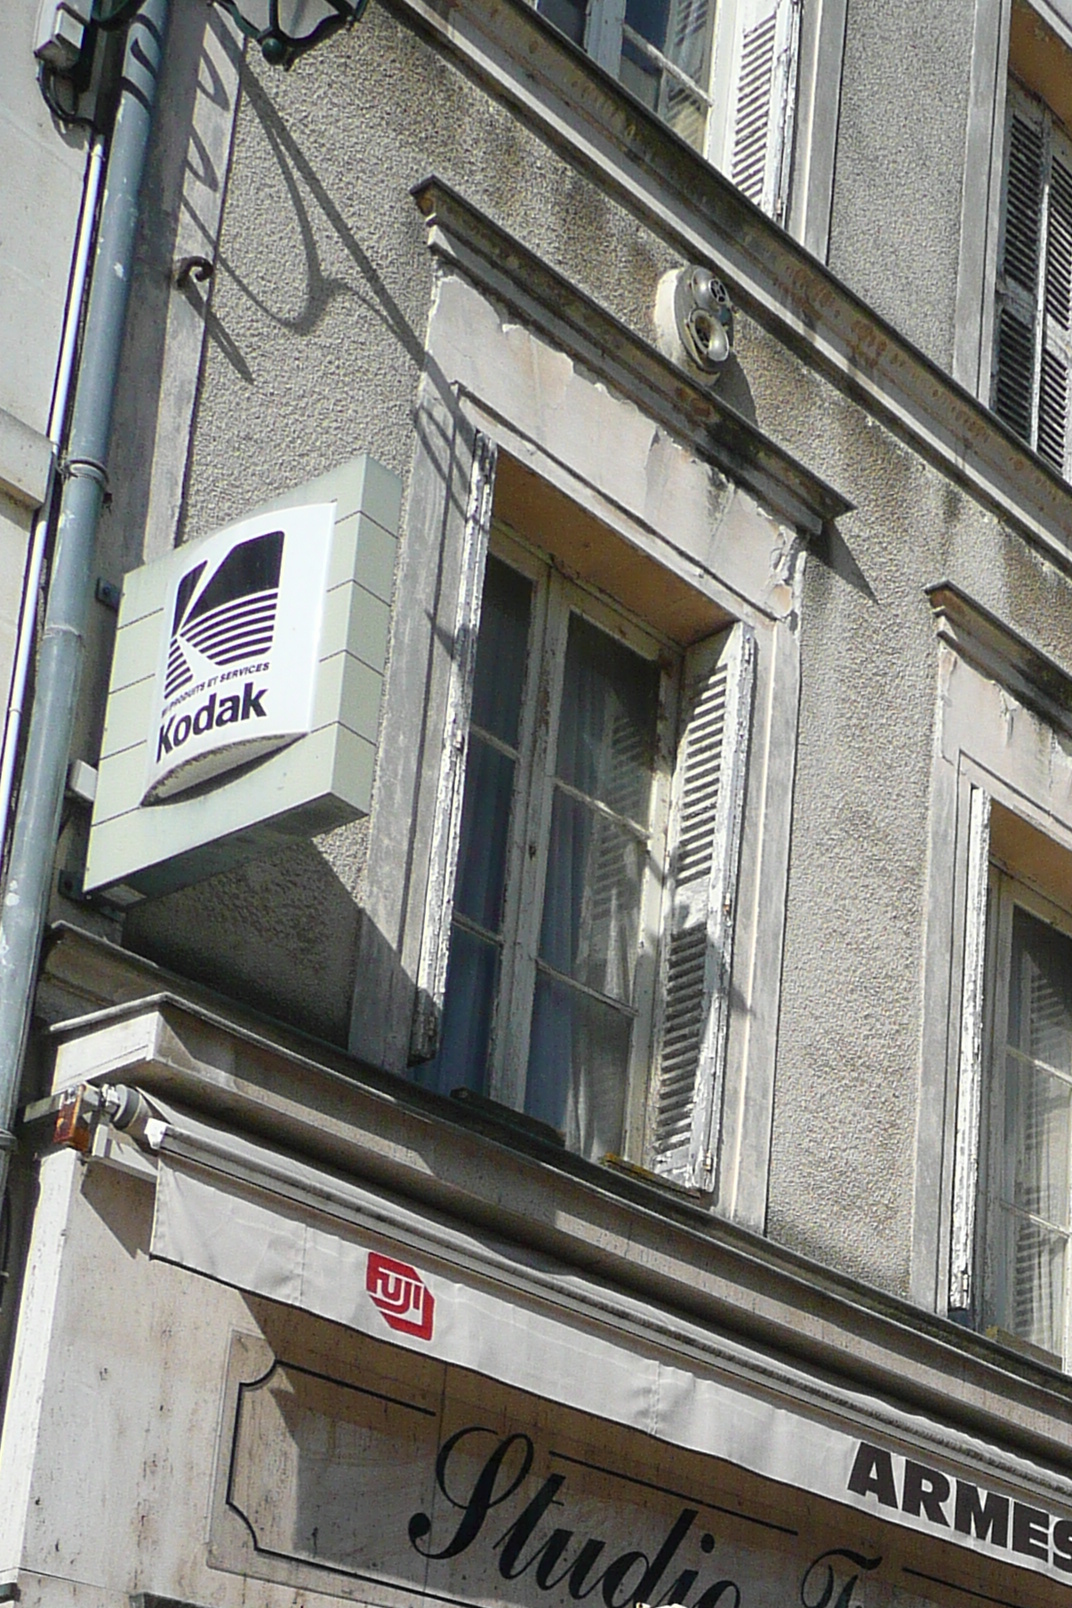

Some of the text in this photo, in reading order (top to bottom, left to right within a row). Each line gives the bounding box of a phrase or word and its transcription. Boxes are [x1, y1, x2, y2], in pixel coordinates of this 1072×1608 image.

[207, 676, 218, 688] ET
[219, 661, 270, 682] SERVICES
[157, 682, 269, 764] Kodak
